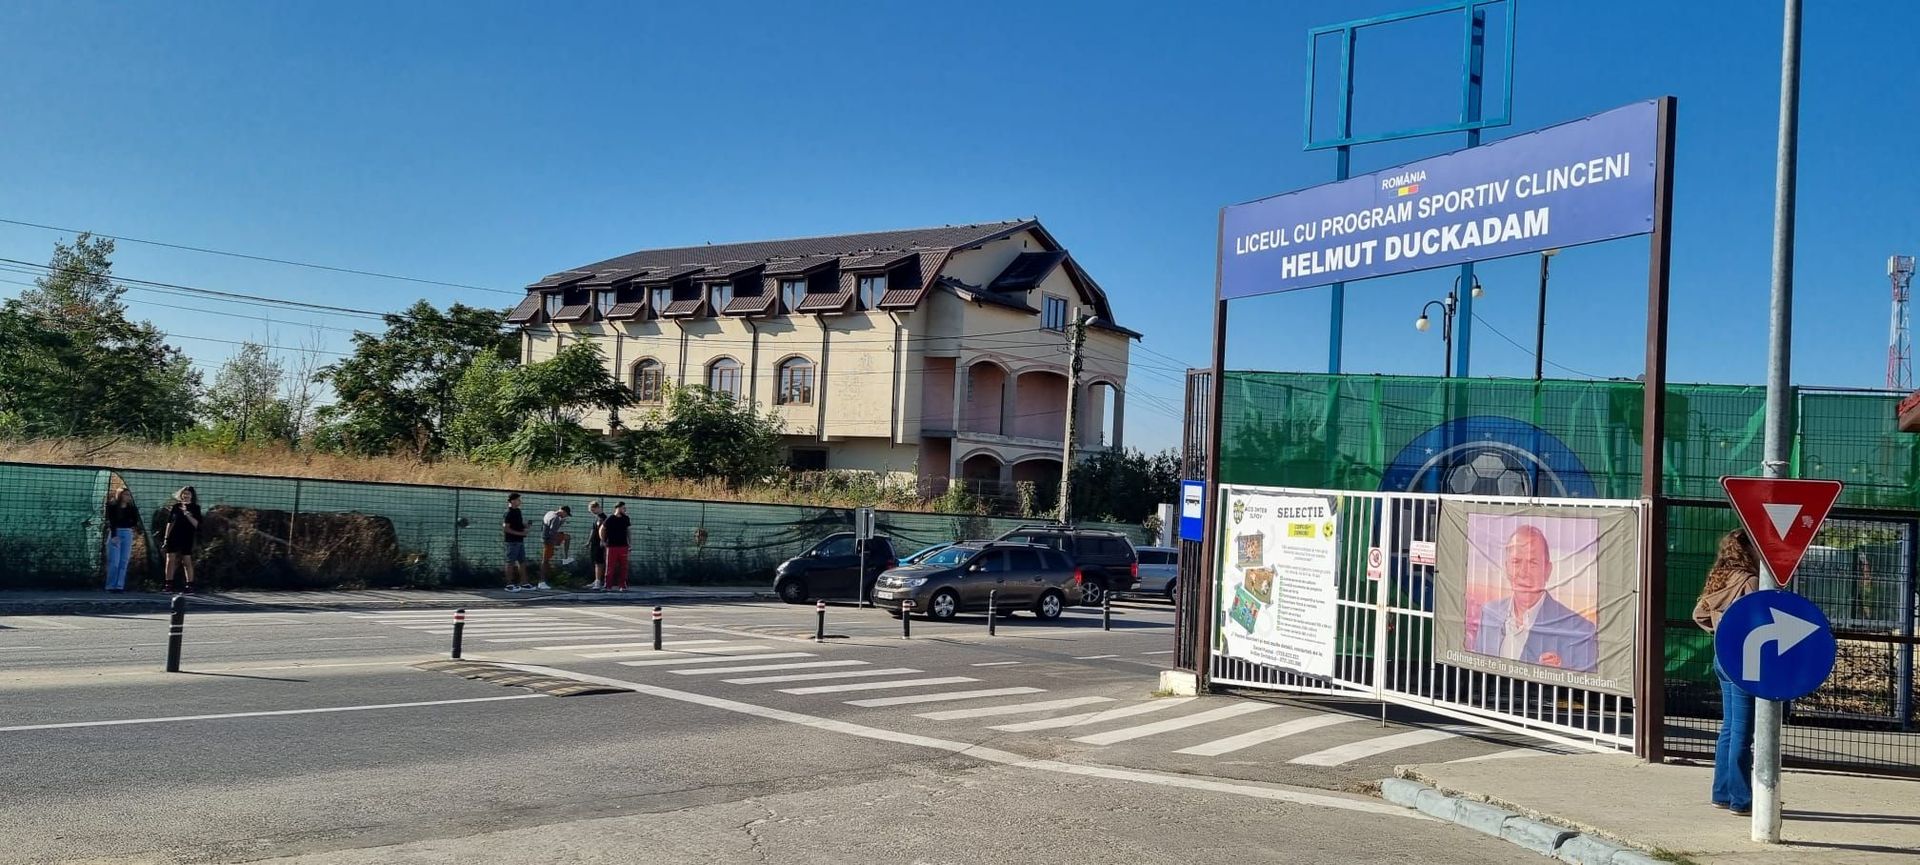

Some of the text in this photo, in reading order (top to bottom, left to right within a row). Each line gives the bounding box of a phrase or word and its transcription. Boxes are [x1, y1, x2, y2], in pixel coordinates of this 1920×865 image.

[1382, 170, 1427, 190] ROMÂNIA
[1236, 152, 1630, 255] LICEUL CU PROGRAM SPORTIV CLINCENI
[1281, 207, 1549, 279] HELMUT DUCKADAM
[1277, 506, 1324, 521] SELECȚIE
[1508, 664, 1531, 678] pace,
[1533, 667, 1565, 682] Helmut
[1567, 672, 1618, 689] Duckadam!
